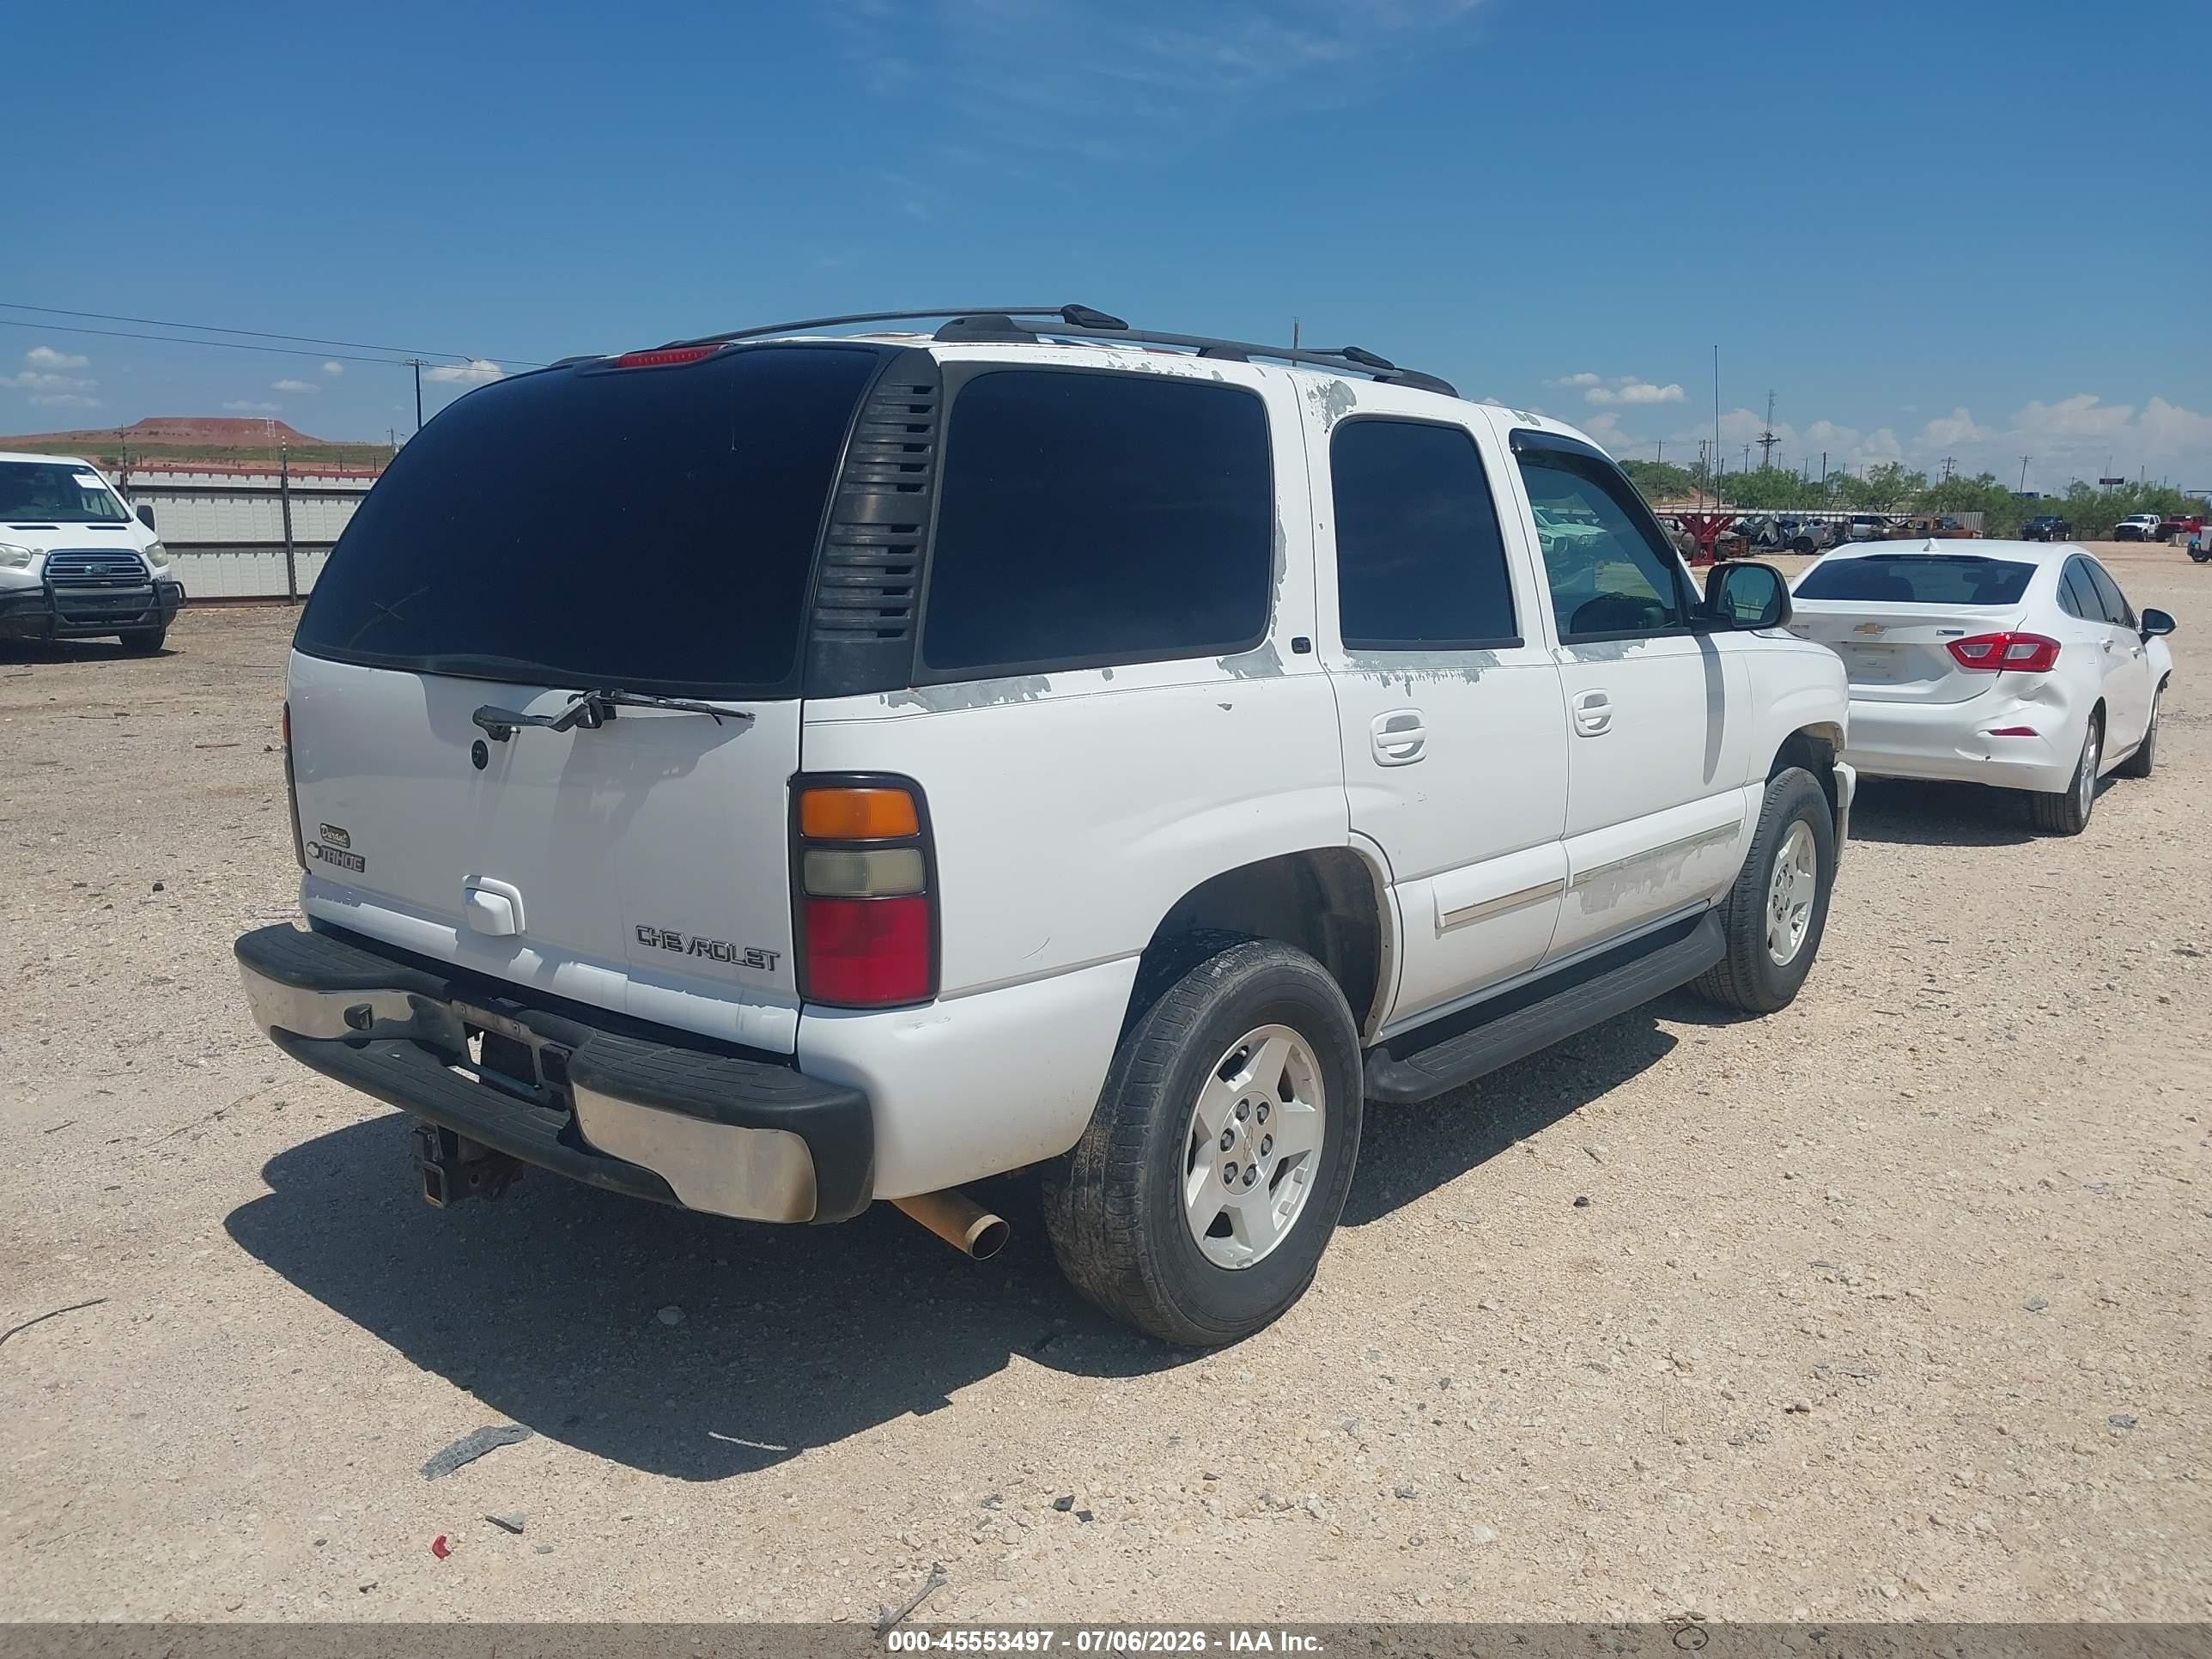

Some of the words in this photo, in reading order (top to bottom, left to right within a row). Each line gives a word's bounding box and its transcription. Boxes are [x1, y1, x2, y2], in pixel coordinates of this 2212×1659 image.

[320, 824, 348, 843] Durant
[321, 848, 364, 872] TAHOE
[635, 925, 781, 971] CHEVROLET
